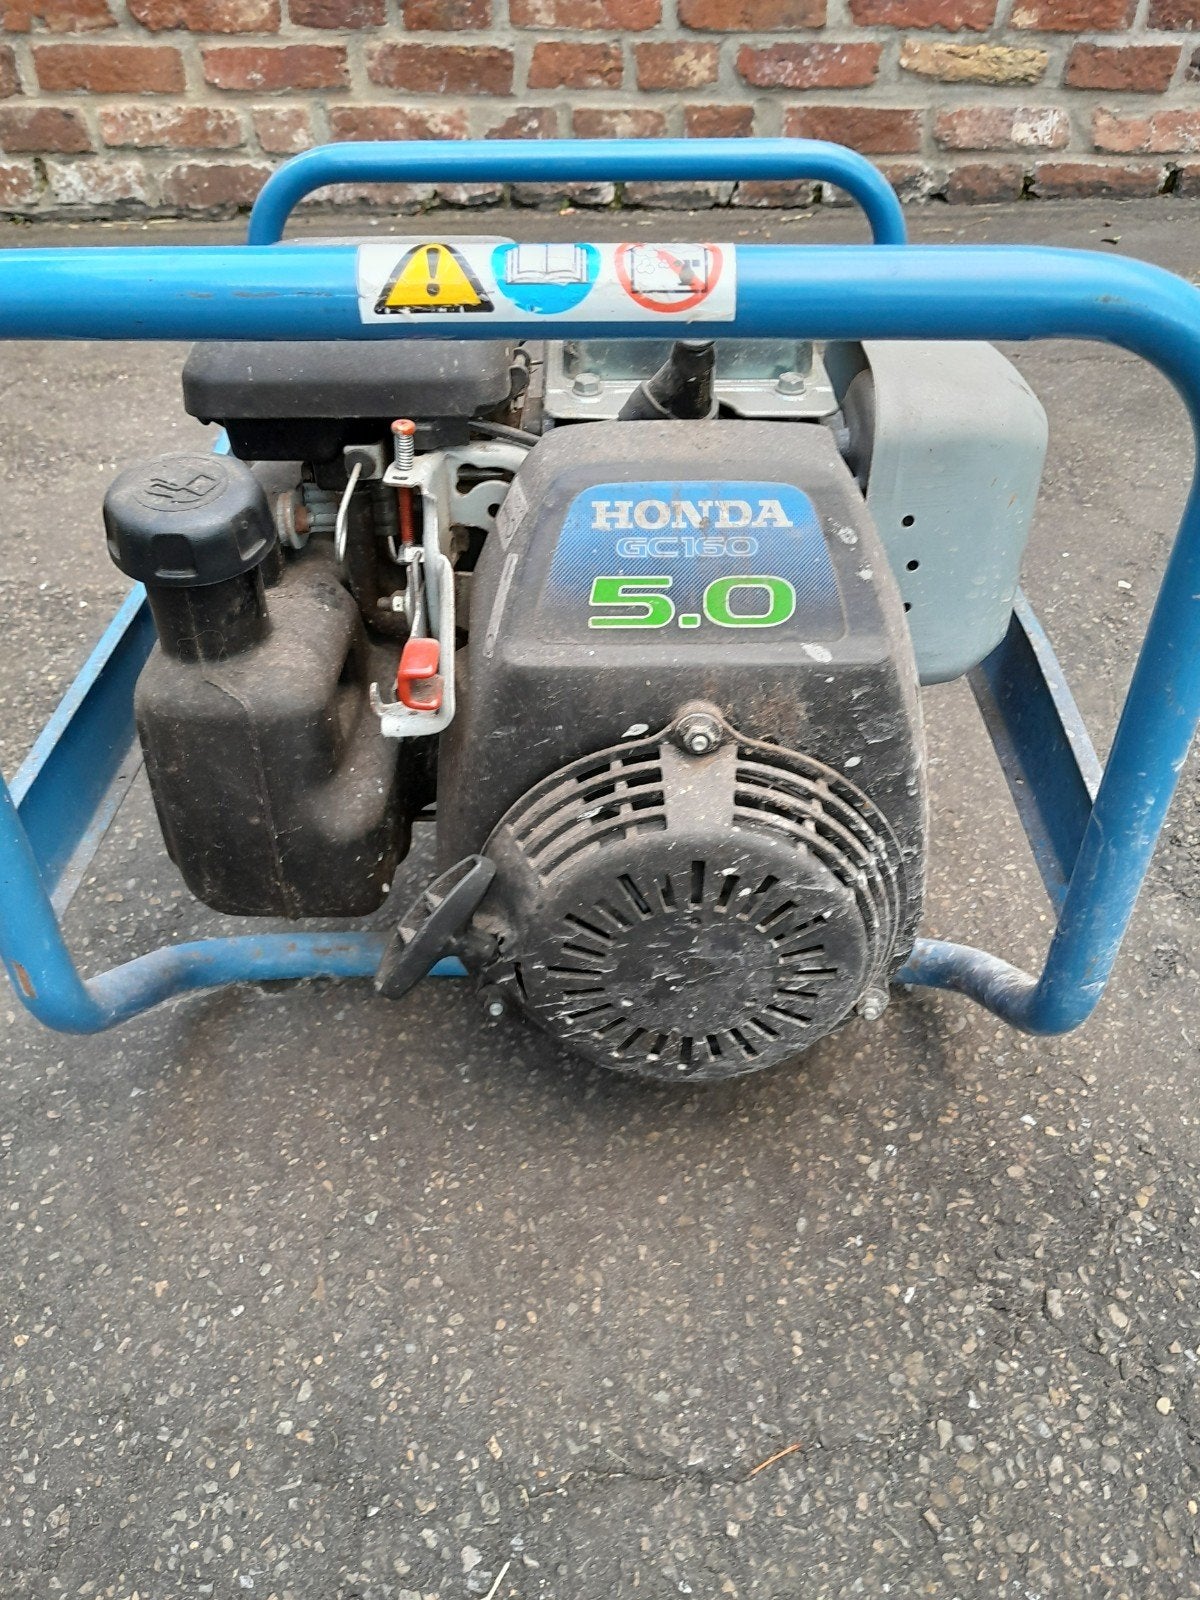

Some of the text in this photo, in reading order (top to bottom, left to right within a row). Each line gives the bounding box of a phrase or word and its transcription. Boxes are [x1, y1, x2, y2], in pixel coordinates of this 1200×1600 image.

[591, 499, 793, 530] HONDA
[616, 536, 758, 558] GC160
[588, 575, 797, 629] 5.0
